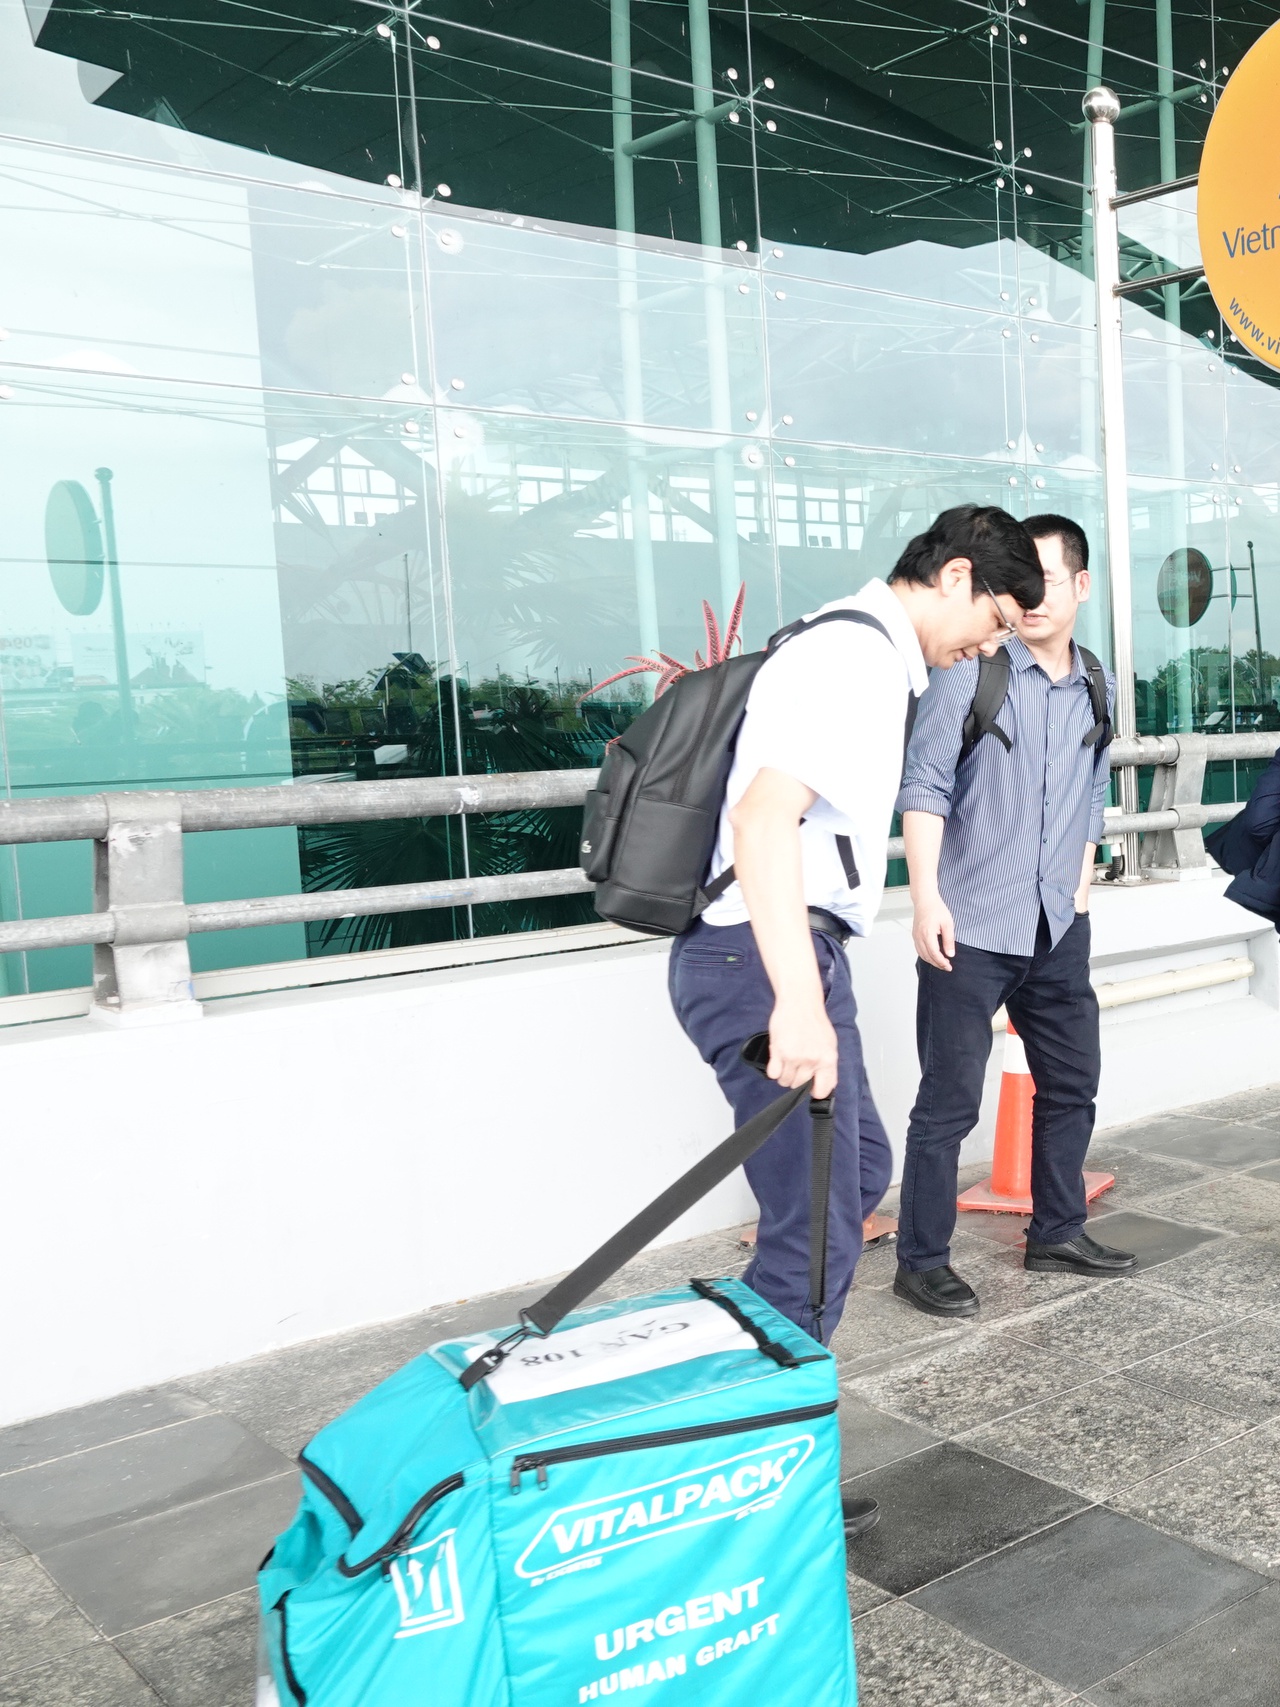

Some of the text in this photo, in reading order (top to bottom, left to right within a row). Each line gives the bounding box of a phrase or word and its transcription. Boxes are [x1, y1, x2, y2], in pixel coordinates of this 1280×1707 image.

[521, 1350, 583, 1366] 108
[551, 1455, 788, 1554] VITALPACK
[579, 1613, 780, 1704] HUMAN GRAFT
[595, 1576, 765, 1660] URGENT
